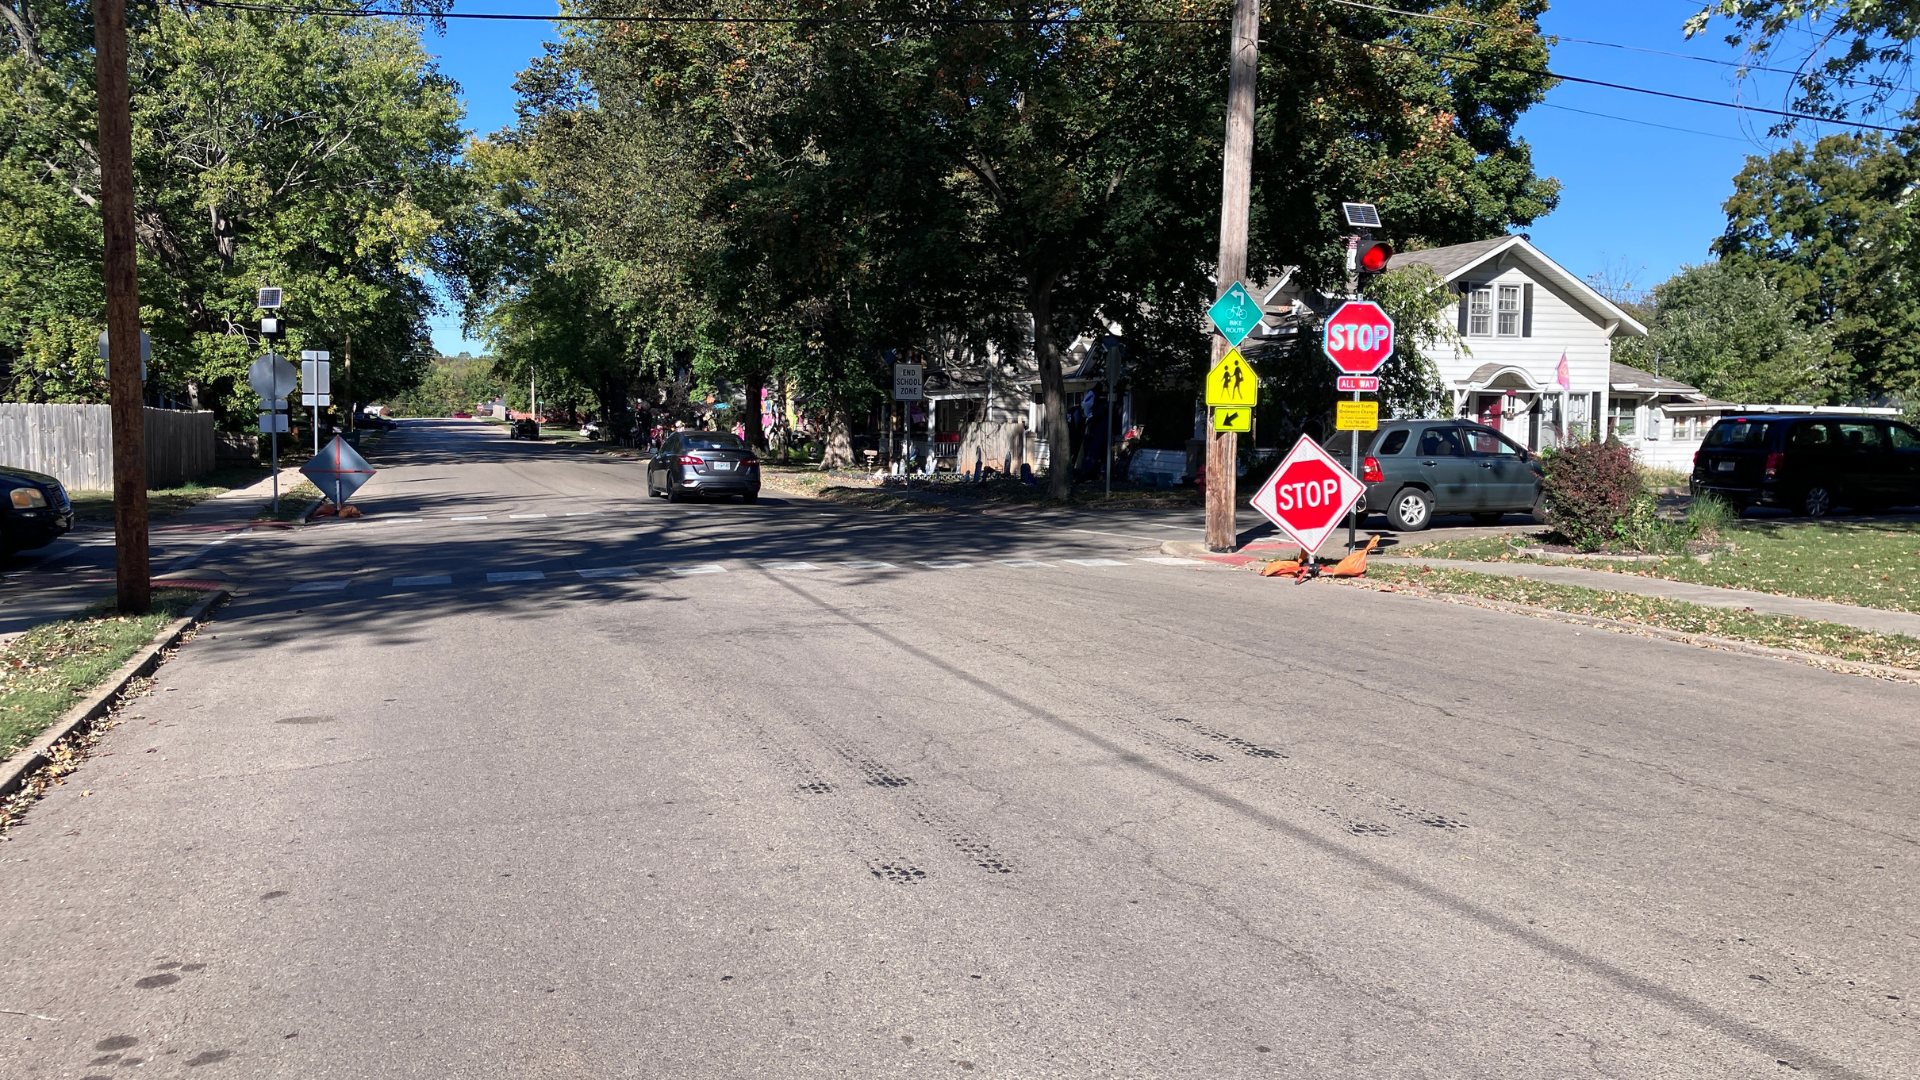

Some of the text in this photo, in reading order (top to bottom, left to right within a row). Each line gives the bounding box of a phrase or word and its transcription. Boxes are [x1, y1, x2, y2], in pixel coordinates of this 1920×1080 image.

[1329, 323, 1389, 351] STOP
[902, 368, 916, 376] END
[896, 377, 922, 386] SCHOOL
[1341, 379, 1375, 388] ALL WAY
[900, 387, 918, 395] ZONE
[1279, 478, 1338, 511] STOP
